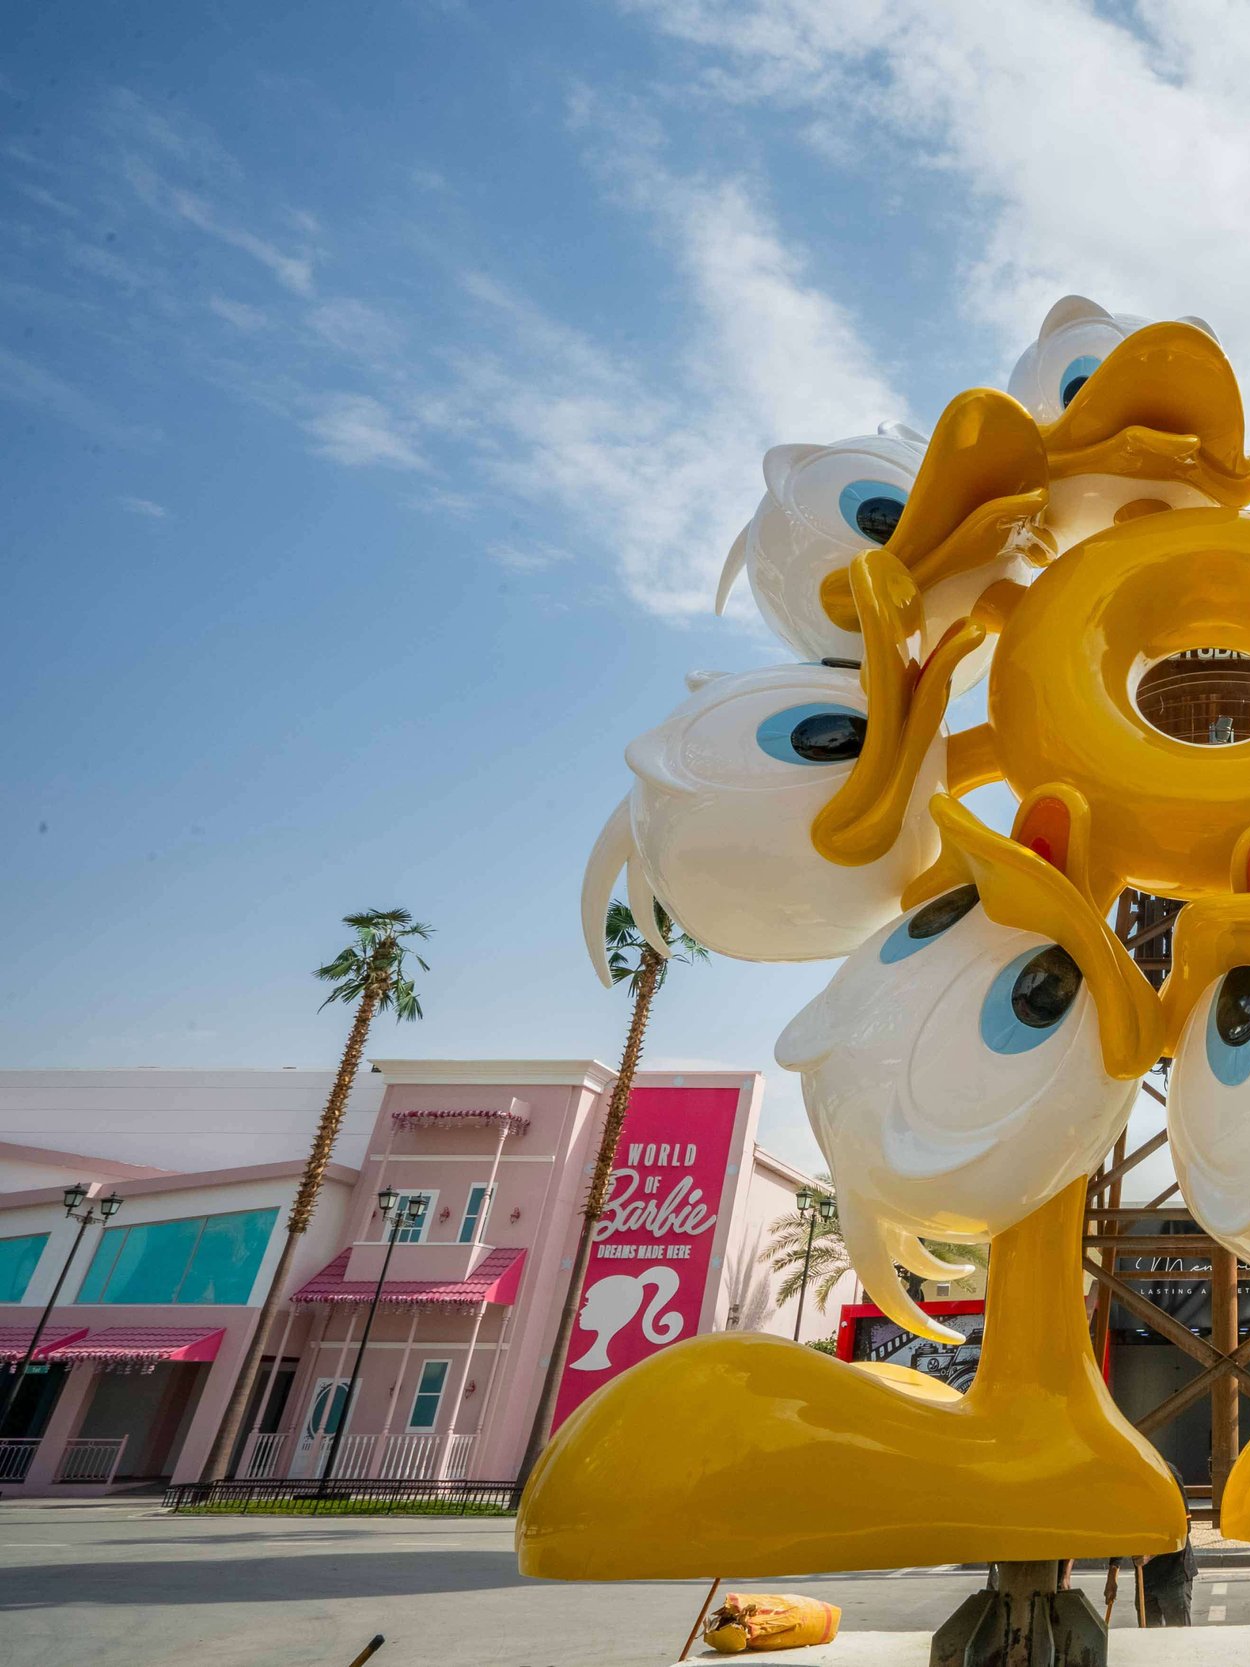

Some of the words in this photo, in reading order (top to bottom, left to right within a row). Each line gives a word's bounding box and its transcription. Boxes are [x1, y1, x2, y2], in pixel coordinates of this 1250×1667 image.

[628, 1143, 697, 1166] WORLD
[644, 1176, 662, 1194] OF
[593, 1168, 717, 1242] Barbie
[597, 1244, 637, 1258] DREAMS
[637, 1244, 665, 1258] MADE
[666, 1244, 692, 1258] HERE
[1140, 1287, 1193, 1295] LASTING
[1201, 1287, 1208, 1295] A
